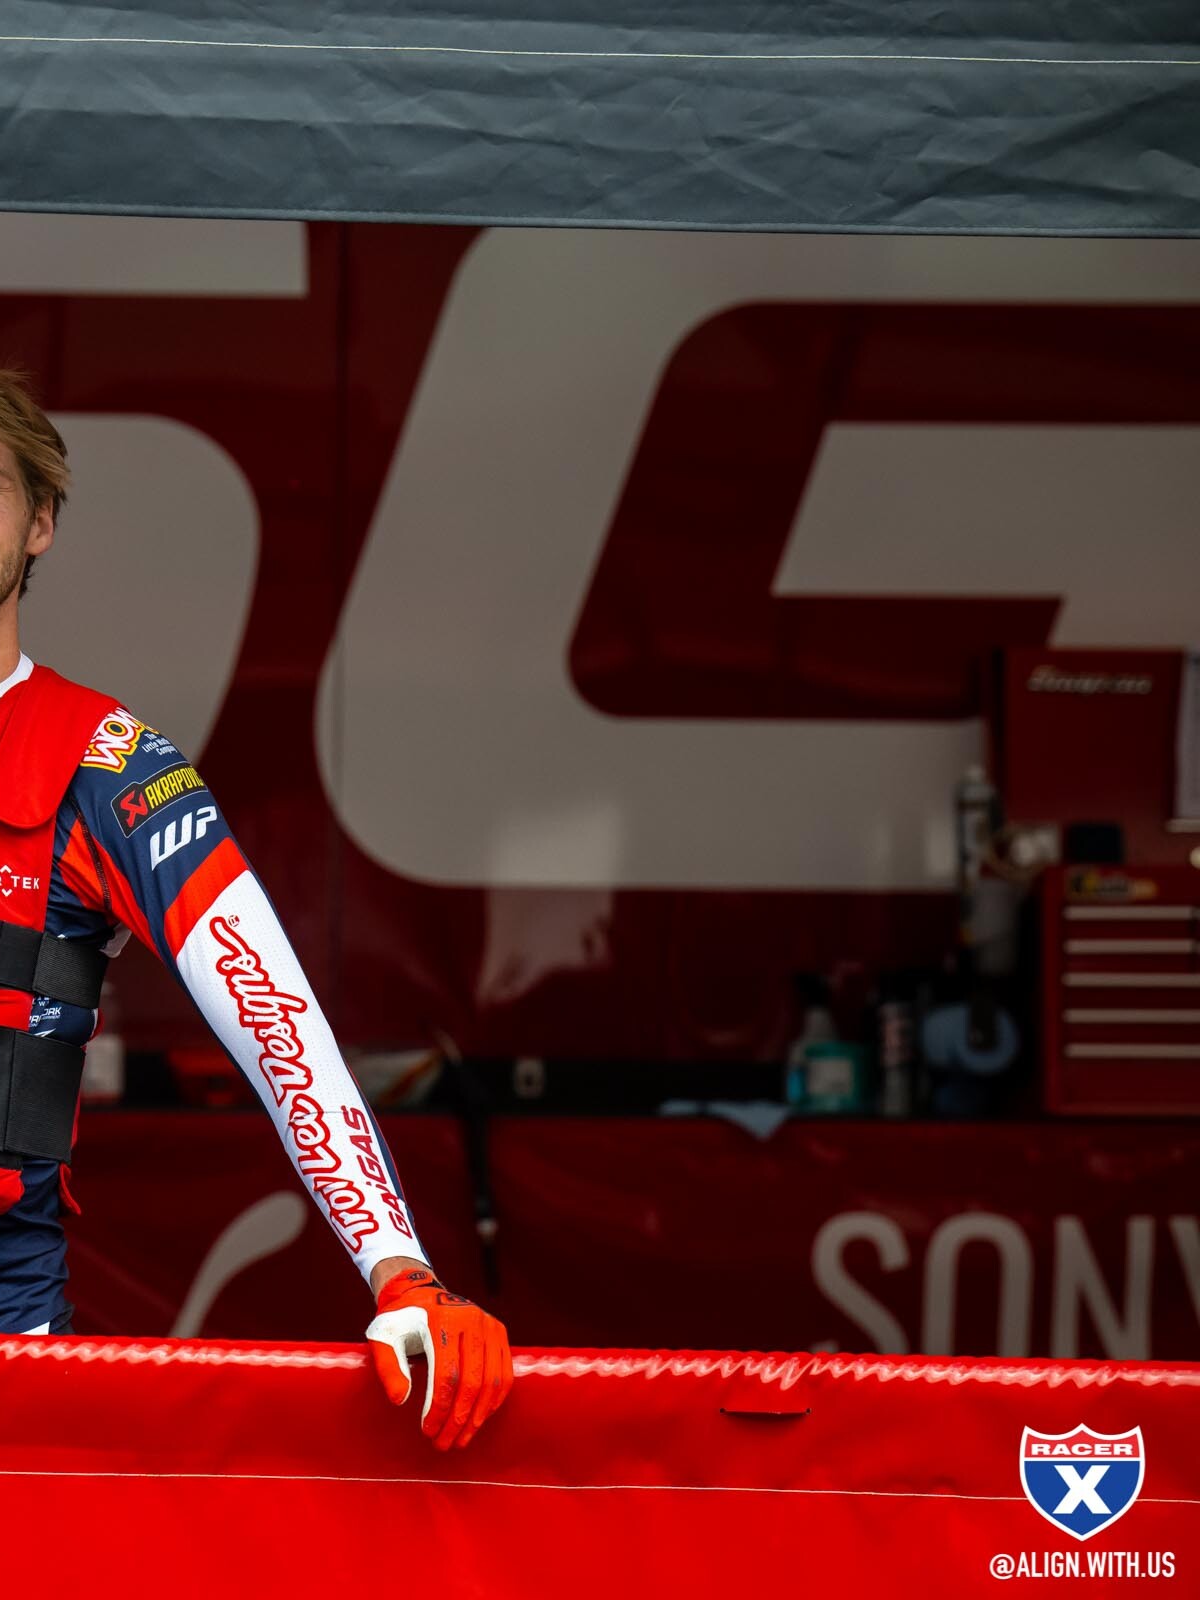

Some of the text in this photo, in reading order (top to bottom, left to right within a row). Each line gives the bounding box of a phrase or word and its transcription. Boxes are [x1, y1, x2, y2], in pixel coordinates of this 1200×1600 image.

[149, 805, 218, 872] WP
[10, 874, 41, 890] TEK
[208, 915, 314, 1109] Designs
[287, 1092, 343, 1177] Lee
